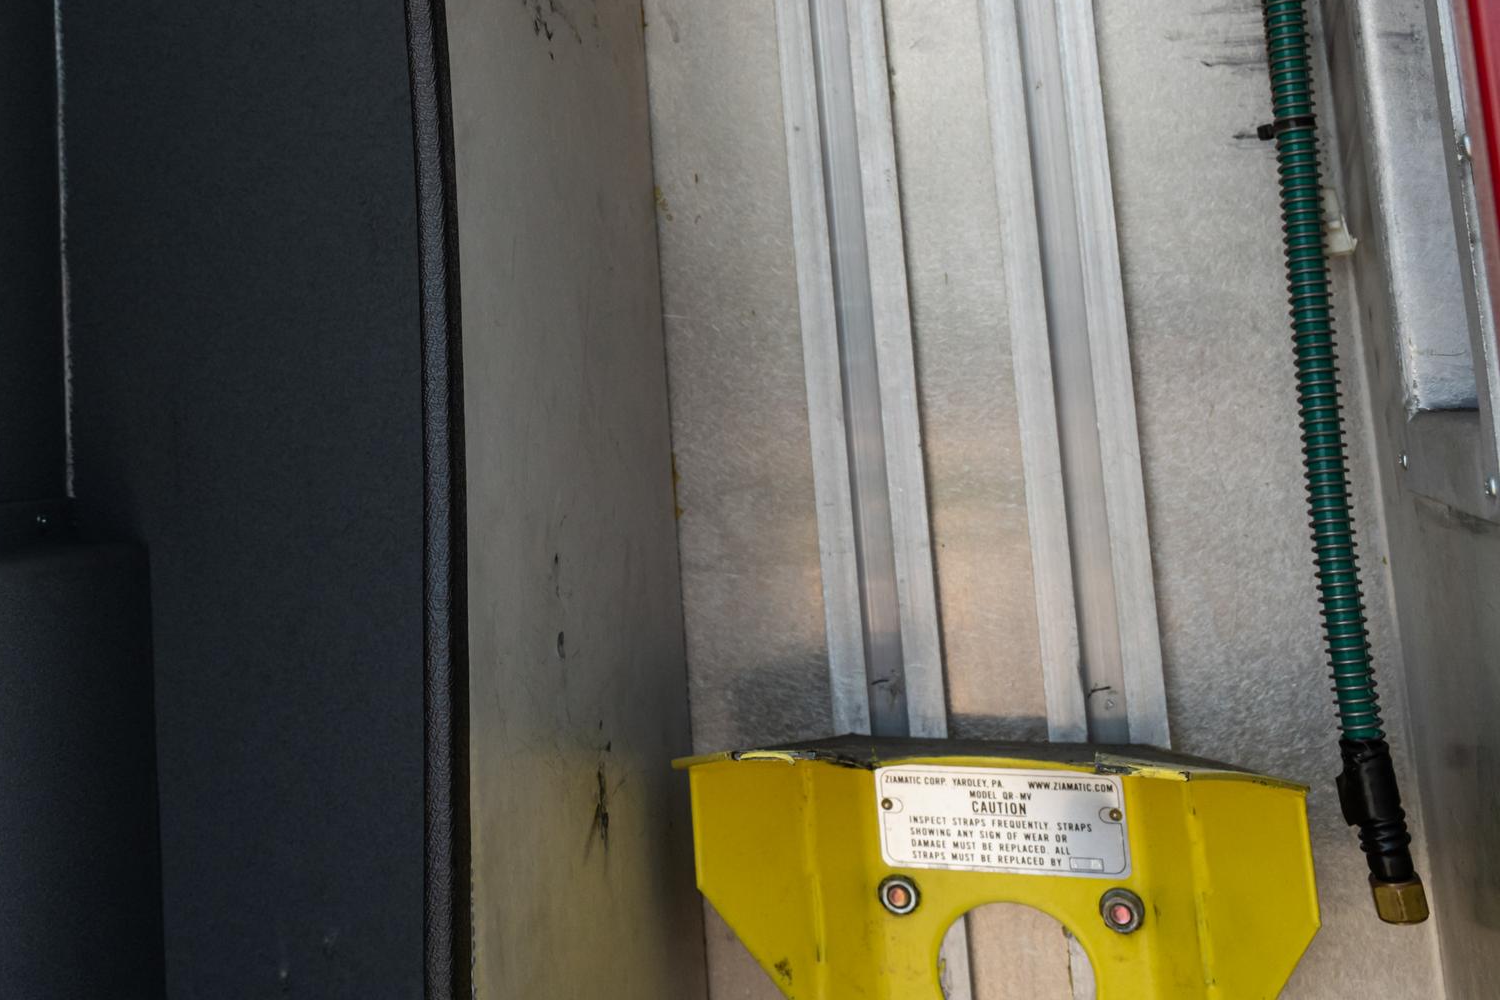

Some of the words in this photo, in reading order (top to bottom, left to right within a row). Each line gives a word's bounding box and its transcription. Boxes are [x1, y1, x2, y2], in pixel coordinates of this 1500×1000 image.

[885, 775, 921, 784] ZIAMATIC
[1027, 781, 1114, 793] WWW.ZIAMATIC.COM
[969, 791, 996, 799] MODEL
[971, 801, 1028, 816] CAUTION
[909, 816, 946, 826] INSPECT
[951, 818, 986, 828] STRAPS
[1055, 822, 1093, 832] STRAPS
[910, 827, 951, 838] SHOWING
[956, 830, 973, 839] ANY
[978, 830, 1001, 840] SIGN
[1005, 832, 1017, 841] OF
[1022, 832, 1050, 842] WEAR
[1054, 834, 1068, 843] OR
[911, 839, 945, 849] DAMAGE
[951, 841, 976, 851] MUST
[981, 842, 992, 851] BE
[1054, 846, 1071, 855] ALL
[912, 850, 946, 861] STRAPS
[950, 852, 974, 862] MUST
[979, 854, 991, 863] BE
[996, 855, 1045, 866] REPLACED
[1049, 858, 1062, 867] BY
